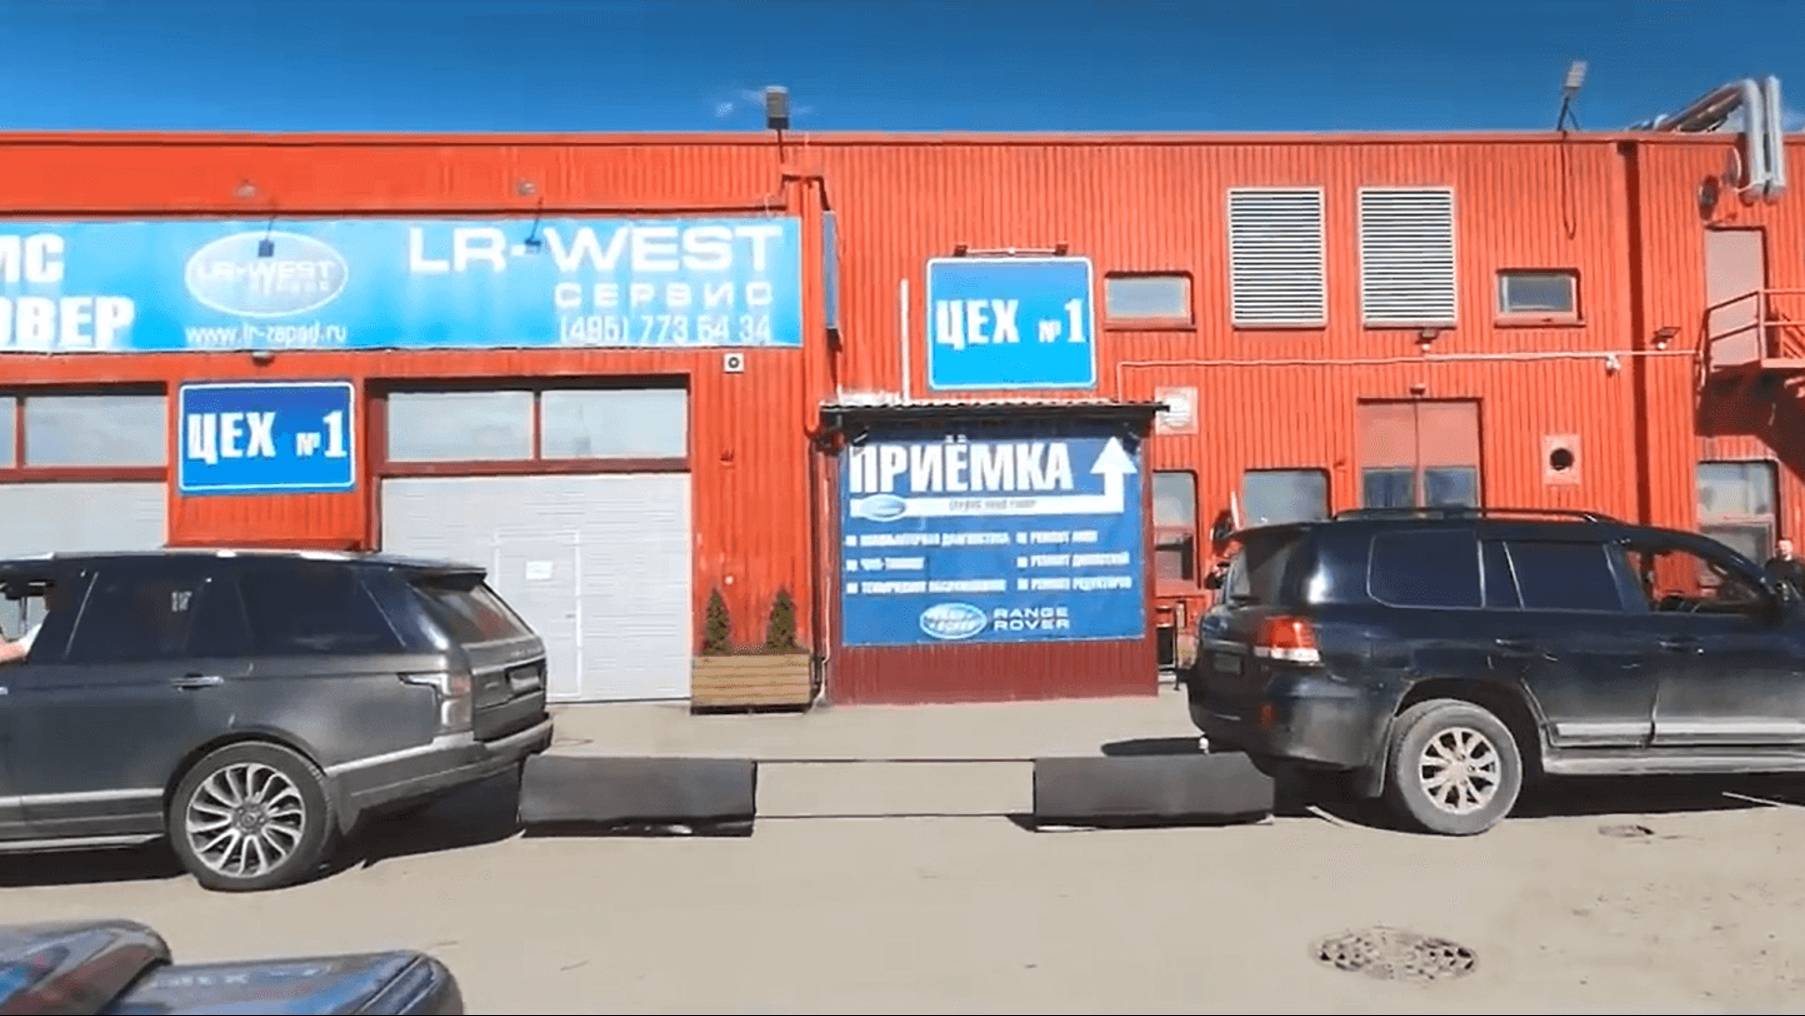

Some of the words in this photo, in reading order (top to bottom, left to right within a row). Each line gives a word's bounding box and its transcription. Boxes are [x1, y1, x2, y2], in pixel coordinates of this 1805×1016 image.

[408, 226, 783, 272] LR-WEST
[554, 281, 773, 308] СЕРВИС
[640, 314, 689, 345] 773
[936, 299, 1020, 350] ЦЕХ
[187, 412, 277, 464] ЦЕХ
[849, 434, 1075, 493] ПРИЁМКА
[993, 607, 1069, 618] RANGE
[993, 619, 1070, 631] ROVER
